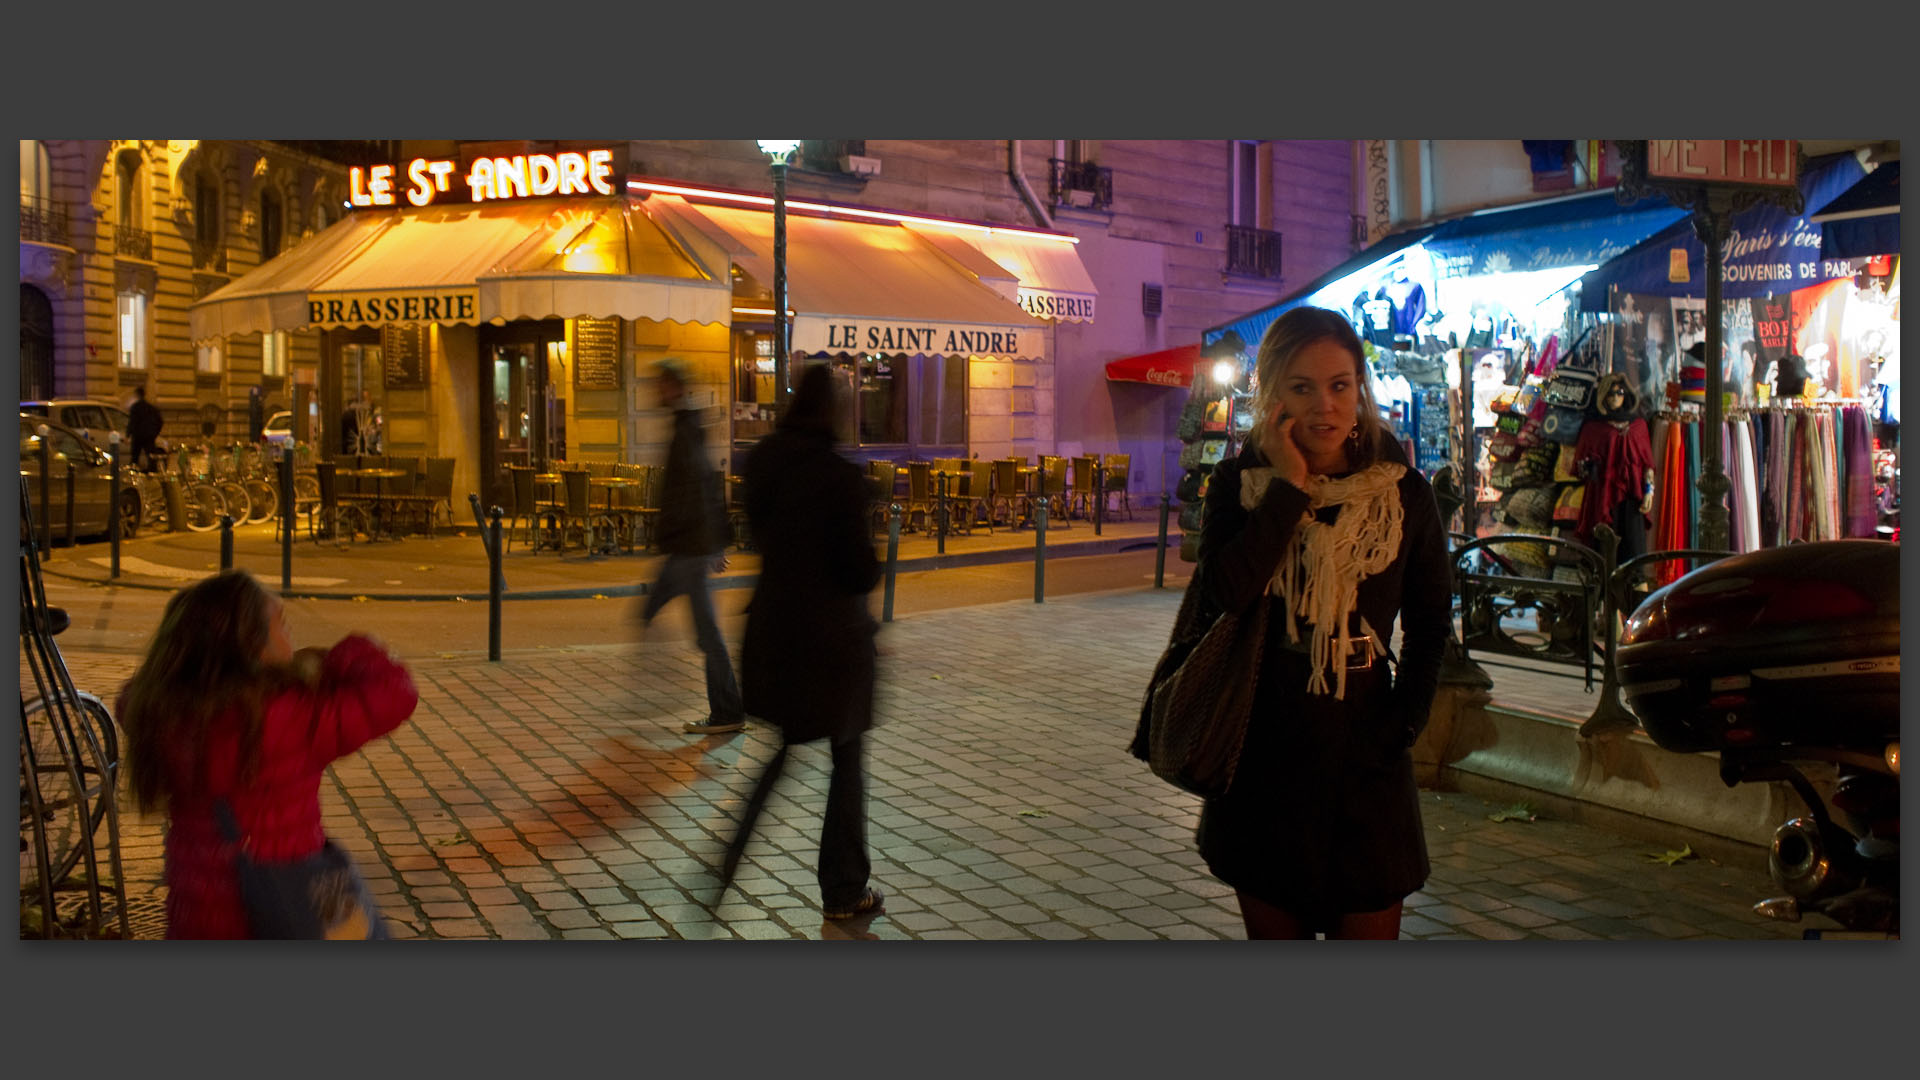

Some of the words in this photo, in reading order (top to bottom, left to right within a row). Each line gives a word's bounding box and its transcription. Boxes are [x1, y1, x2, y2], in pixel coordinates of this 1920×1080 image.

[350, 165, 394, 206] LE
[464, 150, 614, 202] ANDRE
[1721, 228, 1774, 264] Paris
[1722, 263, 1793, 282] SOUVENIRS
[1800, 262, 1816, 279] DE
[1825, 260, 1852, 278] PARI
[308, 295, 475, 324] BRASSERIE
[1017, 295, 1093, 318] RASSERIE
[828, 325, 858, 349] LE
[867, 327, 937, 351] SAINT
[944, 328, 1018, 354] ANDRÉ
